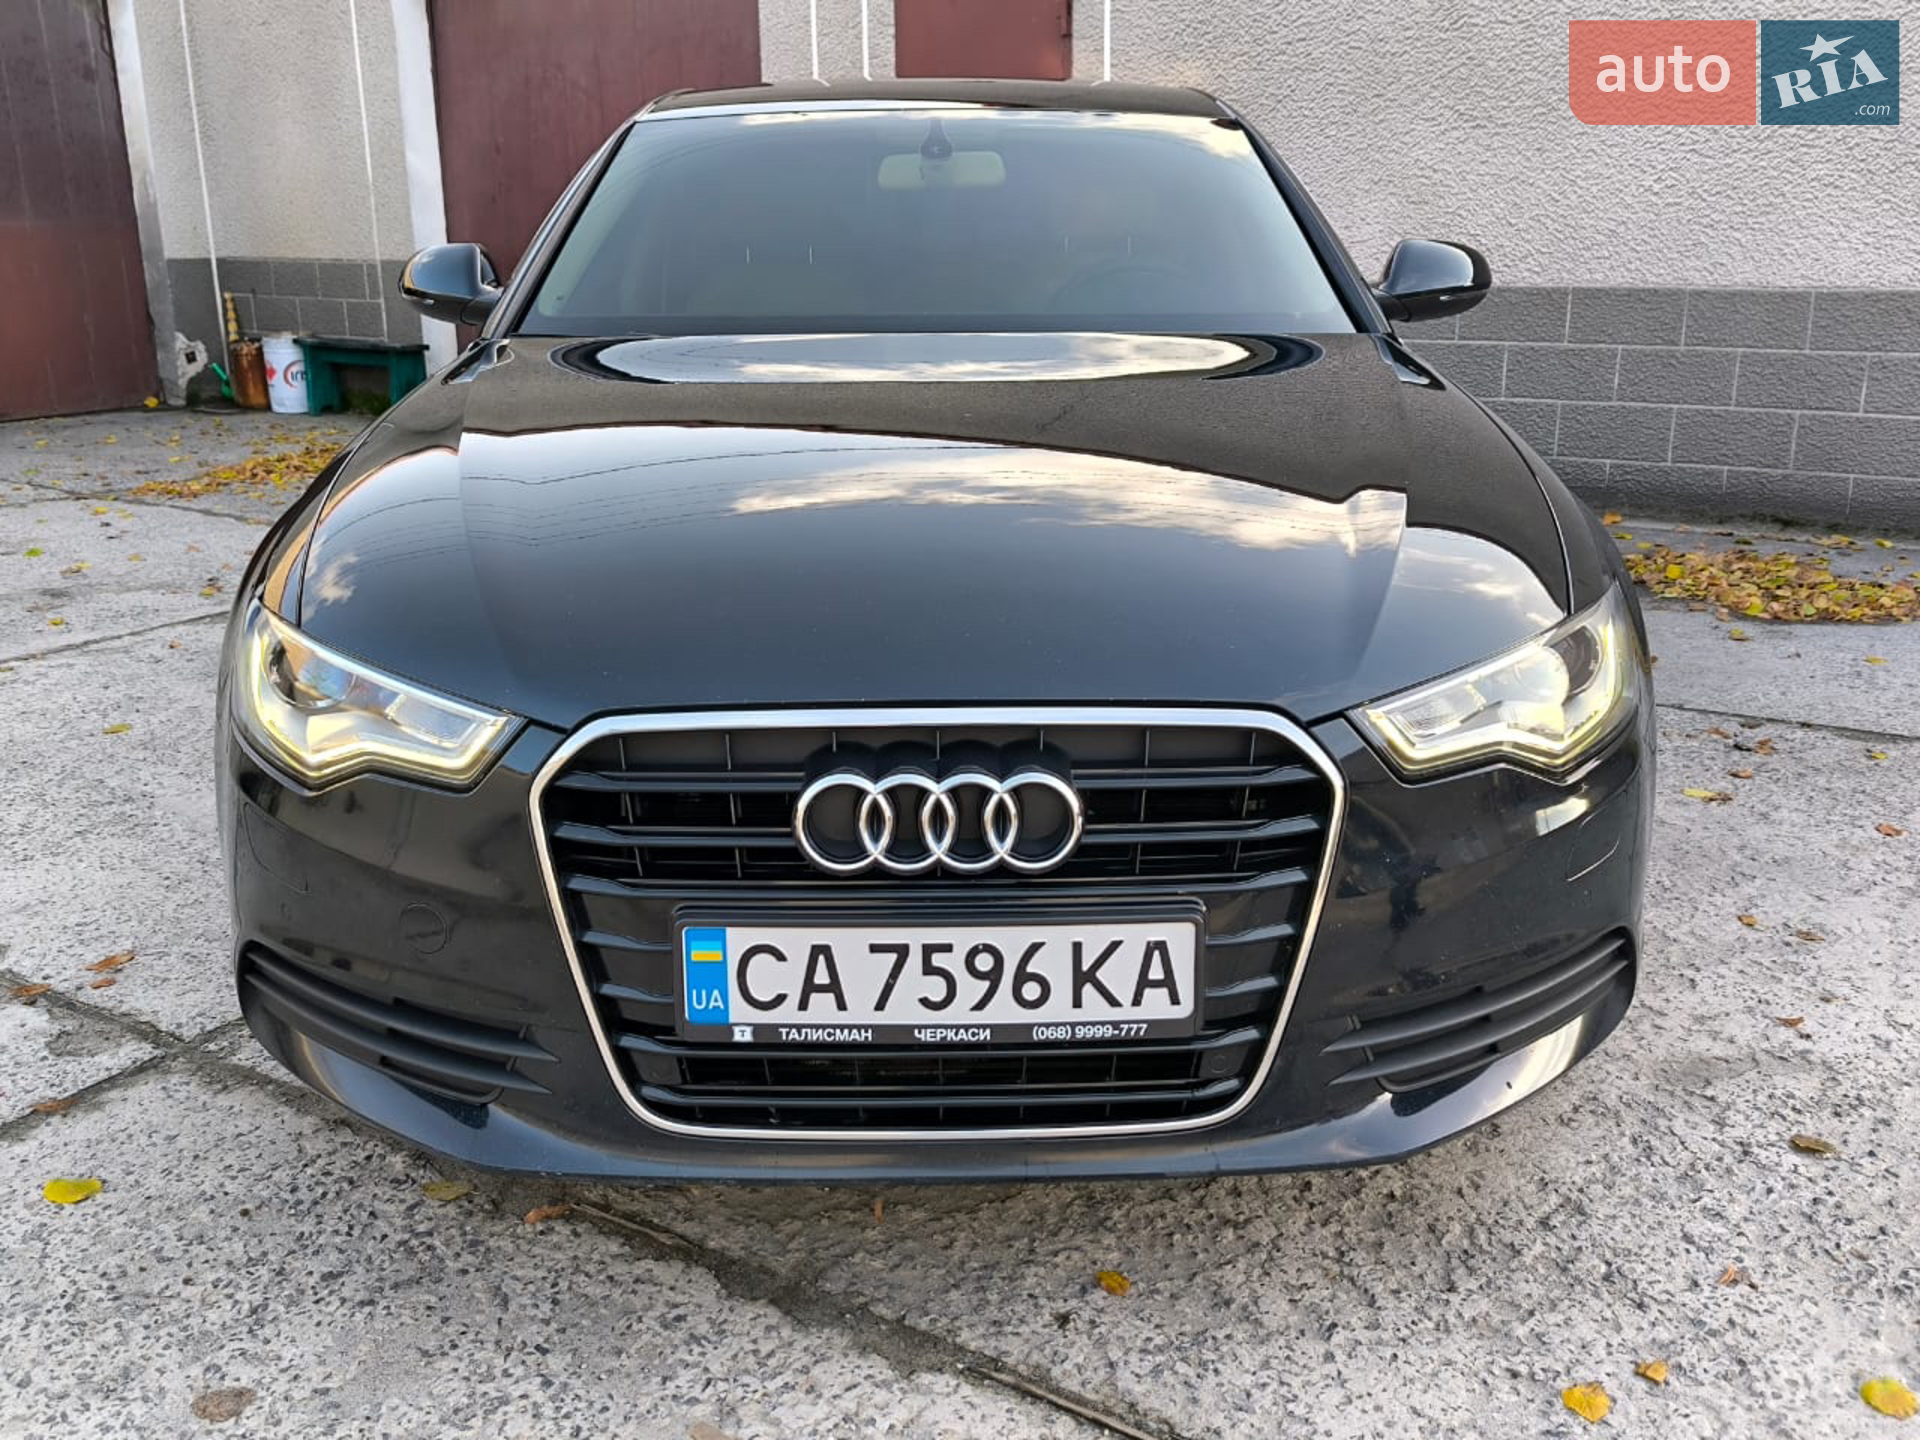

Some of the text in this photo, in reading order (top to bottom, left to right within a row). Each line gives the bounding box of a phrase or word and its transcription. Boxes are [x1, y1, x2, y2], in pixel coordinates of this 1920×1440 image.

[736, 939, 1182, 1012] CA 7596 KA
[692, 988, 725, 1010] UA
[779, 1028, 872, 1042] ТАЛИСМАН
[914, 1027, 991, 1042] ЧЕРКАСИ
[1032, 1025, 1072, 1041] (068)
[1075, 1024, 1148, 1038] 9999-777
